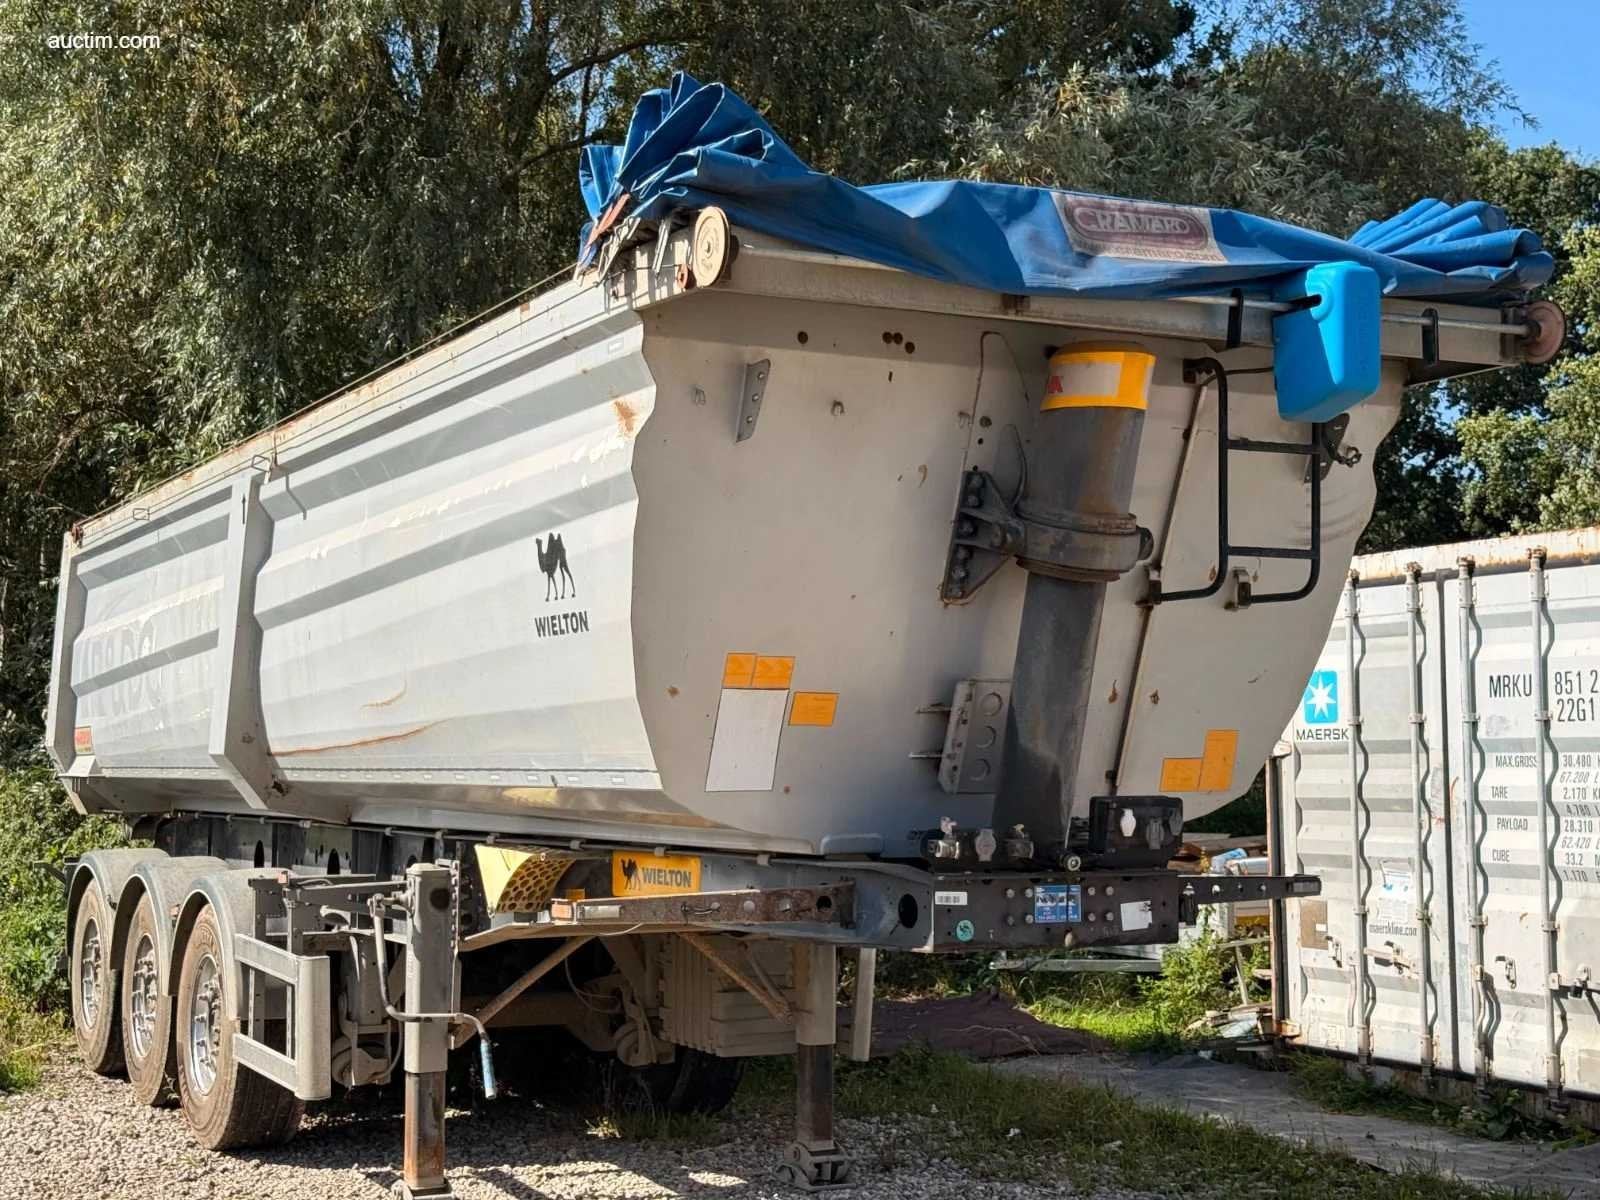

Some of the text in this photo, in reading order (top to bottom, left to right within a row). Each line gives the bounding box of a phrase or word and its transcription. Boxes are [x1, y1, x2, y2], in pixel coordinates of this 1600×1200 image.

[1073, 207, 1190, 234] CRAMARO
[534, 610, 590, 638] WIELTON
[1489, 673, 1532, 698] MRKU
[1554, 669, 1582, 695] 851
[1556, 697, 1595, 722] 22G1
[1296, 728, 1350, 741] MAERSK
[1491, 786, 1508, 799] TARE
[1563, 787, 1587, 800] 2.170
[1496, 817, 1528, 831] PAYLOAD
[1564, 819, 1593, 833] 28.310
[1492, 849, 1510, 862] CUBE
[1565, 852, 1583, 866] 33.2
[641, 866, 692, 888] WIELTON
